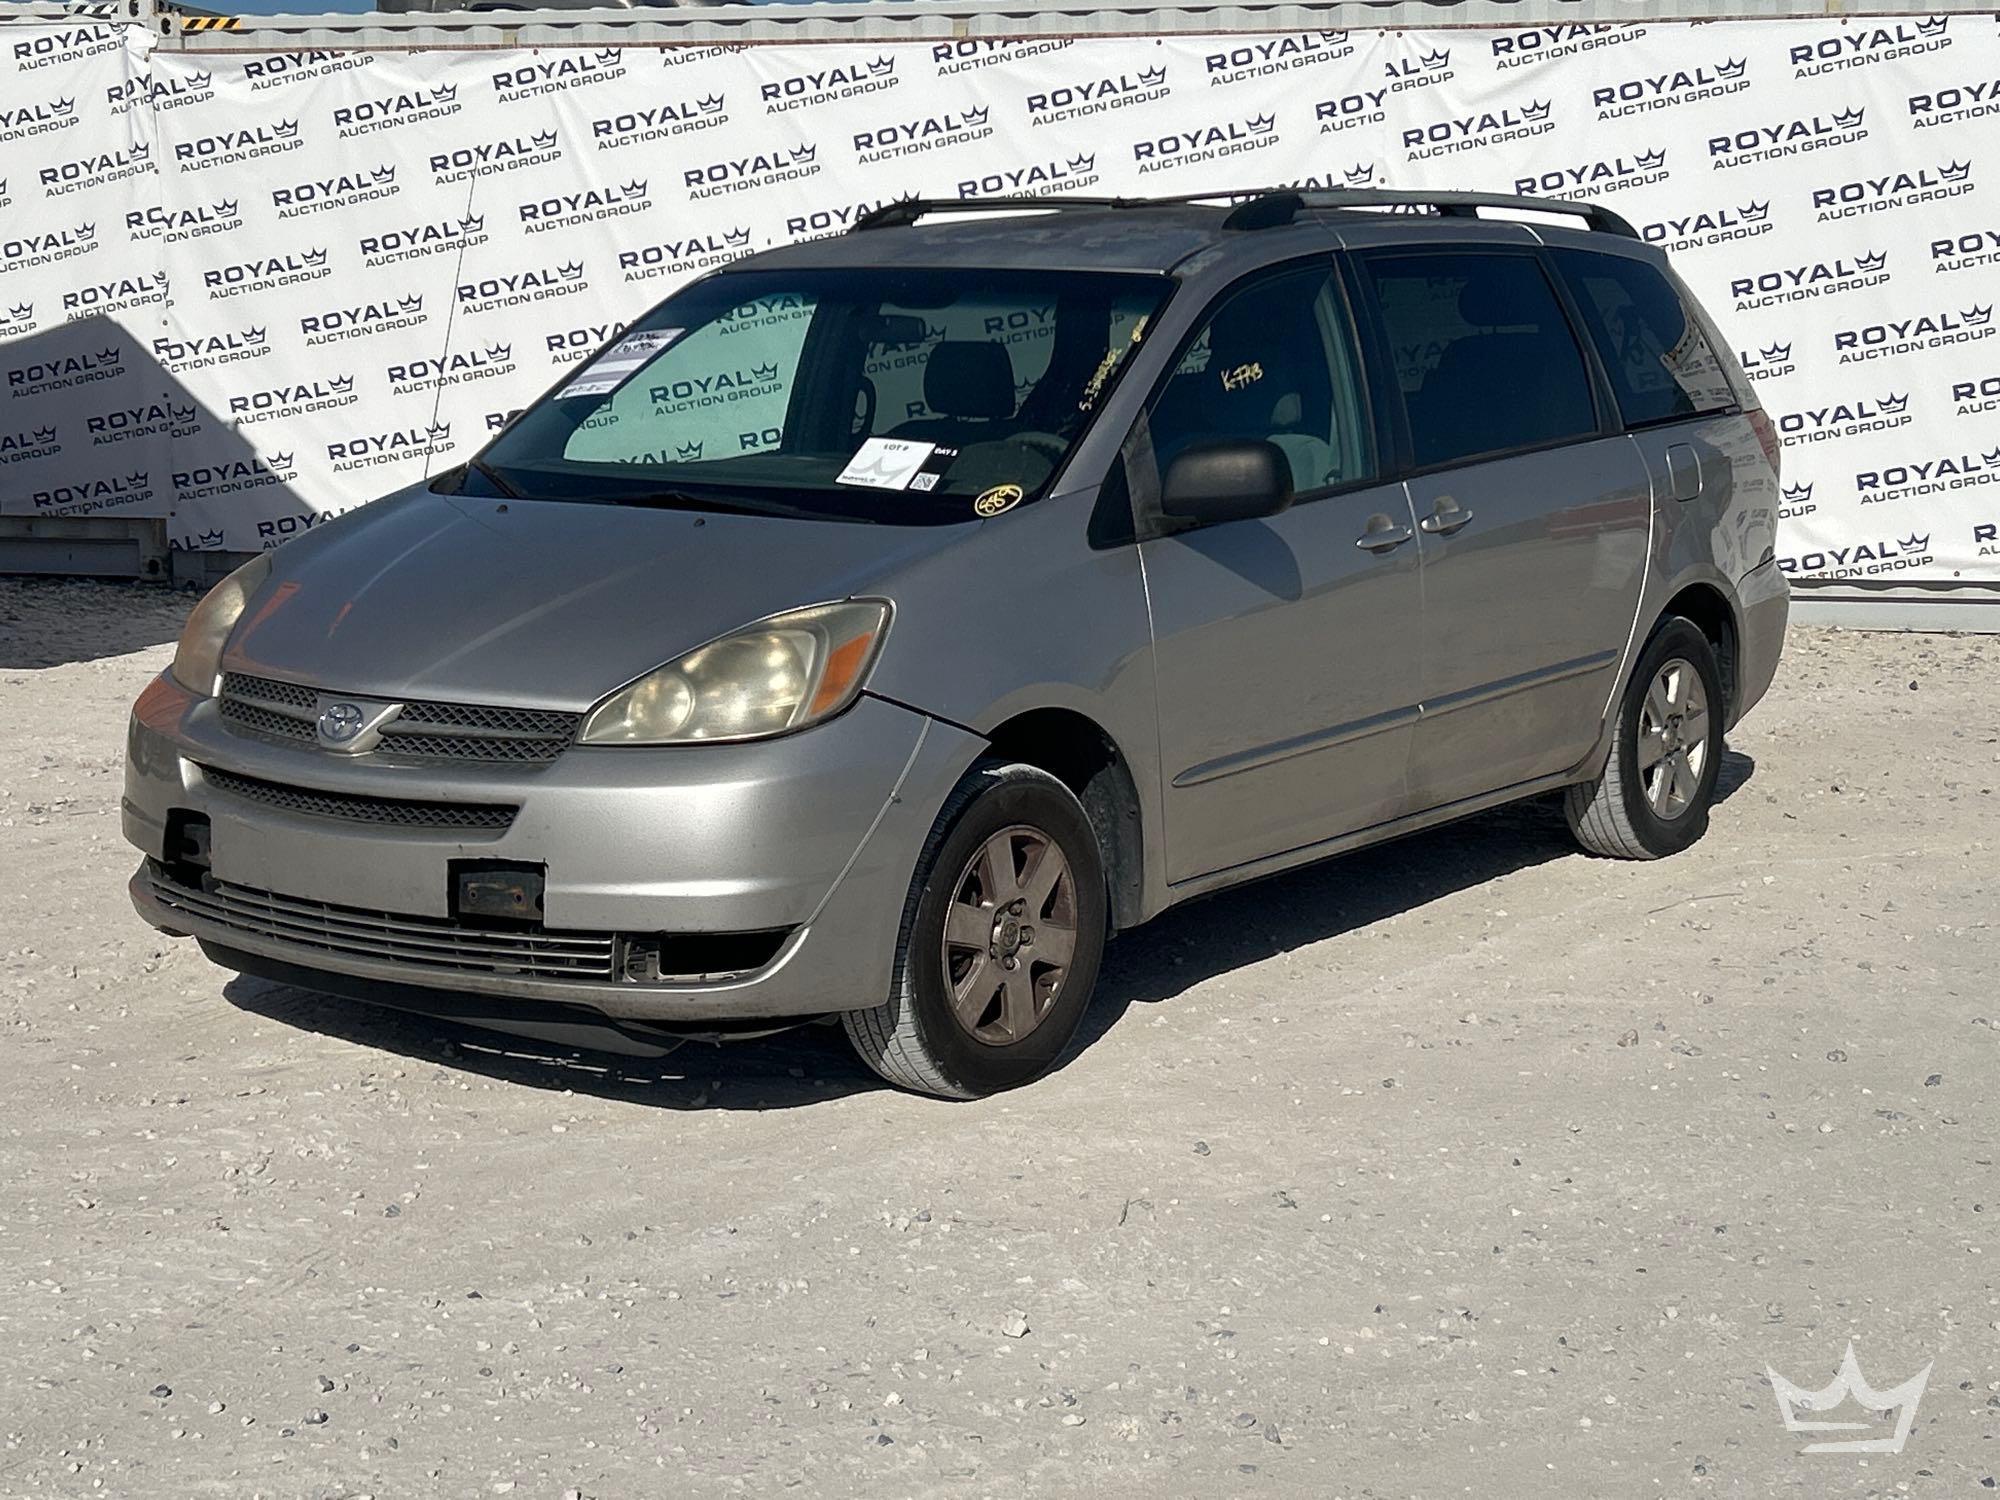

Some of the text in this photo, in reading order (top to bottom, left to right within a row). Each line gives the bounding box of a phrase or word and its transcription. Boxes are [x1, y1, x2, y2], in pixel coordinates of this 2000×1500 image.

[13, 24, 110, 60] ROYAL
[1205, 34, 1321, 73] ROYAL
[1496, 28, 1647, 71] AUCTION GROUP
[1789, 24, 1916, 65] ROYAL
[1794, 38, 1952, 80] AUCTION GROUP
[18, 50, 83, 72] AUCTION
[251, 55, 374, 91] AUCTION GROUP
[492, 56, 597, 91] ROYAL
[937, 52, 1012, 77] AUCTION
[1211, 46, 1354, 87] AUCTION GROUP
[498, 68, 626, 104] AUCTION GROUP
[761, 65, 868, 101] ROYAL
[767, 77, 899, 114] AUCTION GROUP
[1027, 75, 1138, 113] ROYAL
[1391, 71, 1454, 93] GROUP
[1593, 67, 1715, 107] ROYAL
[162, 90, 215, 112] GROUP
[333, 91, 432, 127] ROYAL
[1032, 88, 1171, 127] AUCTION GROUP
[1598, 80, 1751, 121] AUCTION GROUP
[1913, 103, 2000, 129] AUCTION
[27, 116, 80, 136] GROUP
[339, 103, 462, 139] AUCTION GROUP
[592, 102, 698, 138] ROYAL
[598, 115, 729, 151] AUCTION GROUP
[853, 115, 962, 151] ROYAL
[1402, 109, 1521, 148] ROYAL
[1708, 117, 1833, 157] ROYAL
[174, 127, 274, 161] ROYAL
[180, 139, 304, 173] AUCTION GROUP
[429, 138, 533, 173] ROYAL
[858, 127, 993, 165] AUCTION GROUP
[1134, 123, 1247, 161] ROYAL
[1138, 135, 1280, 174] AUCTION GROUP
[1407, 122, 1555, 162] AUCTION GROUP
[1713, 130, 1869, 171] AUCTION GROUP
[39, 151, 130, 185] ROYAL
[46, 162, 155, 198] AUCTION GROUP
[435, 151, 562, 186] AUCTION GROUP
[684, 152, 790, 187] ROYAL
[690, 165, 821, 200] AUCTION GROUP
[958, 162, 1068, 200] ROYAL
[1514, 158, 1635, 197] ROYAL
[1604, 171, 1669, 193] GROUP
[272, 173, 372, 207] ROYAL
[278, 185, 400, 219] AUCTION GROUP
[1040, 175, 1099, 196] GROUP
[1812, 170, 1938, 209] ROYAL
[519, 188, 622, 222] ROYAL
[525, 200, 652, 234] AUCTION GROUP
[1817, 183, 1975, 223] AUCTION GROUP
[191, 218, 243, 238] GROUP
[360, 222, 459, 256] ROYAL
[1642, 210, 1738, 243] OYAL
[1707, 223, 1773, 245] GROUP
[54, 241, 99, 261] GROUP
[366, 234, 489, 268] AUCTION GROUP
[618, 235, 724, 269] ROYAL
[203, 255, 303, 288] ROYAL
[210, 268, 332, 300] AUCTION GROUP
[457, 269, 559, 303] ROYAL
[625, 260, 695, 282] AUCTION
[1731, 260, 1855, 298] ROYAL
[63, 276, 154, 310] ROYAL
[463, 282, 588, 315] AUCTION GROUP
[1736, 273, 1890, 312] AUCTION GROUP
[66, 300, 128, 322] AUCTION
[300, 302, 399, 334] ROYAL
[719, 314, 788, 336] AUCTION
[306, 314, 428, 346] AUCTION GROUP
[1834, 313, 1961, 351] ROYAL
[1839, 327, 1996, 365] AUCTION GROUP
[7, 354, 97, 387] ROYAL
[219, 346, 271, 364] GROUP
[387, 351, 487, 383] ROYAL
[12, 367, 125, 399] AUCTION GROUP
[393, 364, 516, 396] AUCTION GROUP
[649, 371, 753, 404] ROYAL
[229, 382, 330, 413] ROYAL
[234, 394, 358, 427] AUCTION GROUP
[655, 383, 782, 416] AUCTION GROUP
[1779, 402, 1877, 433] OYAL
[1845, 415, 1912, 436] GROUP
[93, 425, 157, 446] AUCTION
[327, 429, 426, 460] ROYAL
[10, 445, 62, 464] GROUP
[333, 442, 455, 473] AUCTION GROUP
[171, 457, 270, 490] ROYAL
[178, 471, 298, 502] AUCTION GROUP
[1856, 455, 1982, 491] ROYAL
[1860, 467, 2000, 505] AUCTION GROU
[32, 478, 128, 508] ROYAL
[105, 490, 153, 507] GROUP
[1776, 542, 1898, 574] ROYAL
[1866, 556, 1933, 575] GROUP
